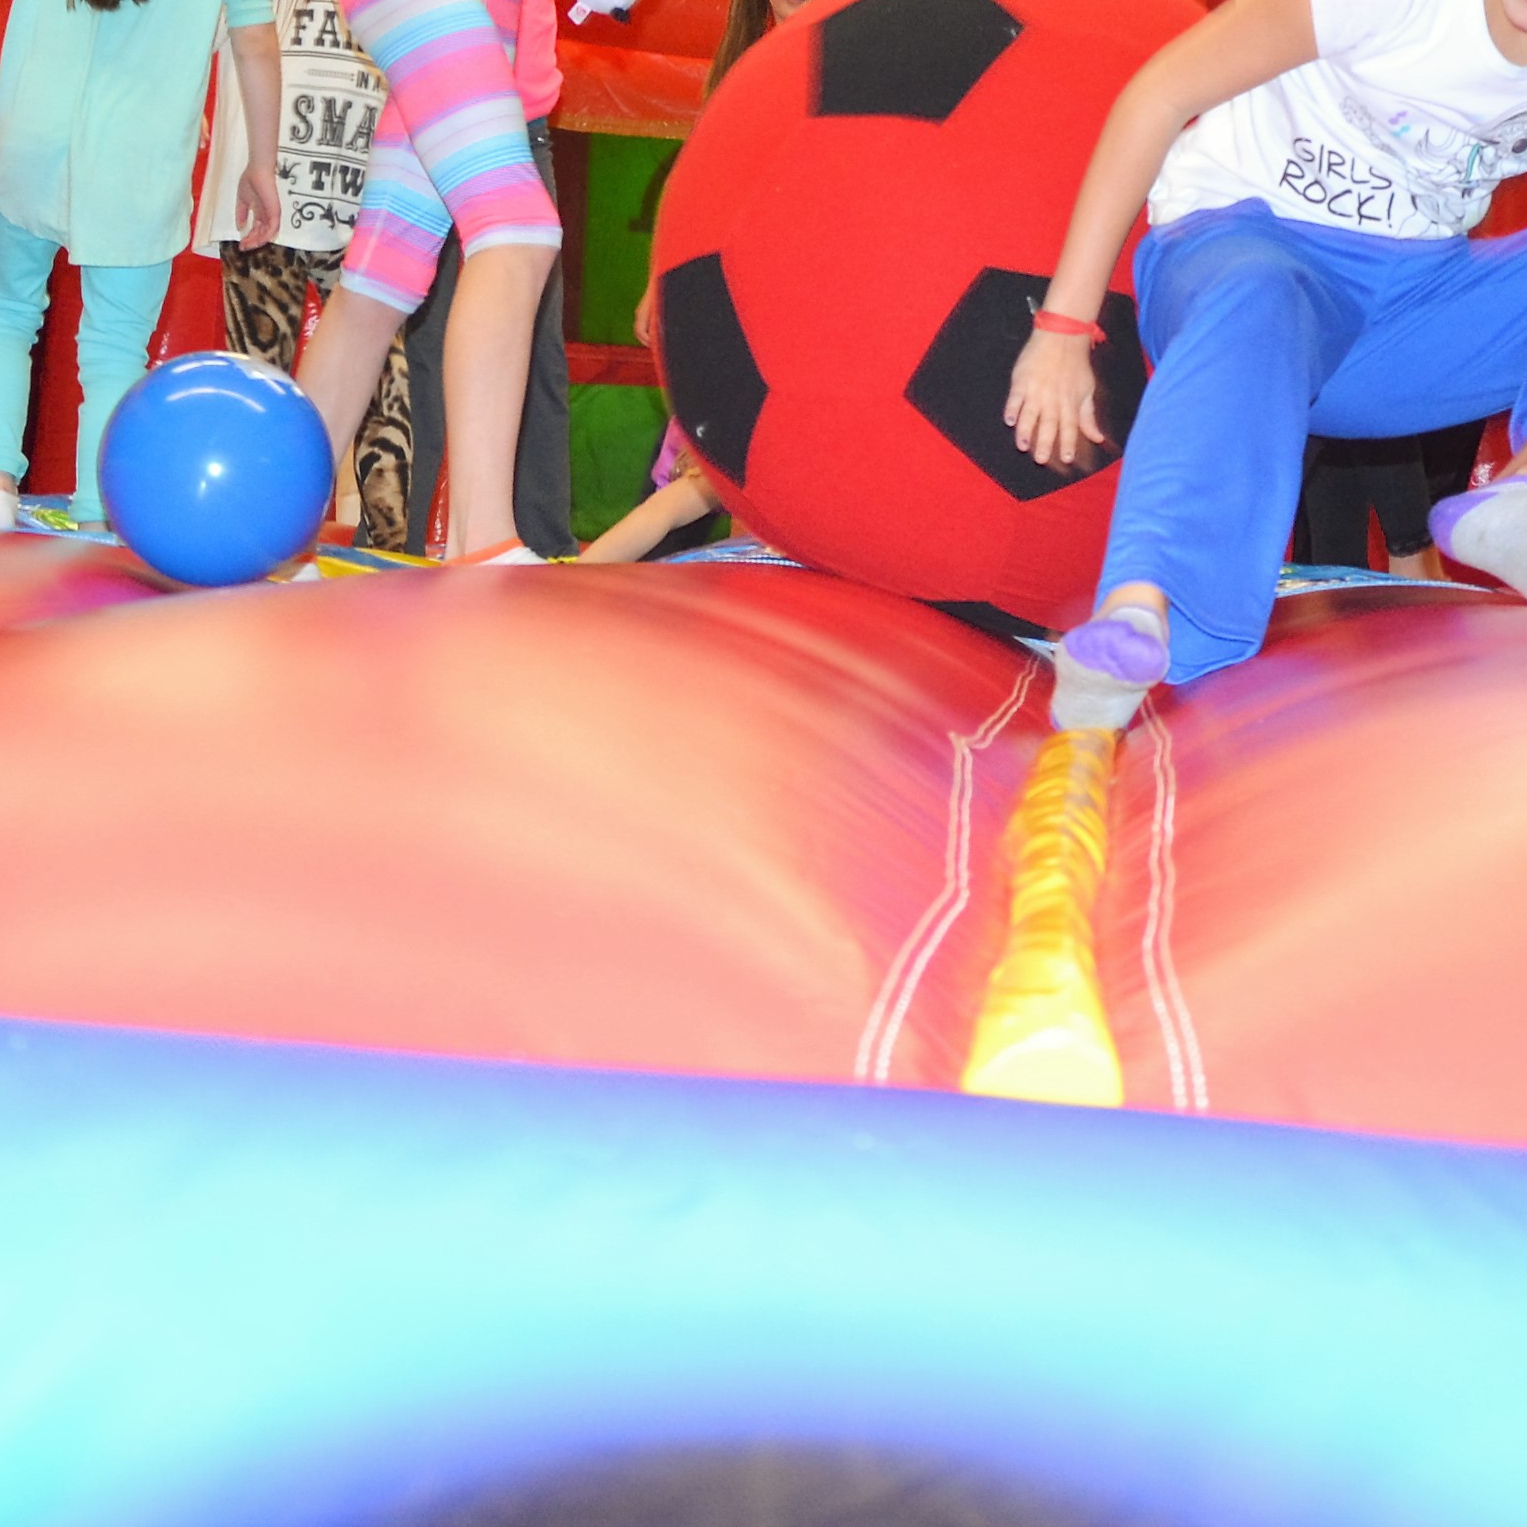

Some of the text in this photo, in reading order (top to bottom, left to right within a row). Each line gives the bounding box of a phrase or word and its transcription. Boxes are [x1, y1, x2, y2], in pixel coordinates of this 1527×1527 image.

[356, 70, 370, 90] IN
[1293, 138, 1392, 190] GIRLS
[1280, 159, 1395, 228] ROCK!
